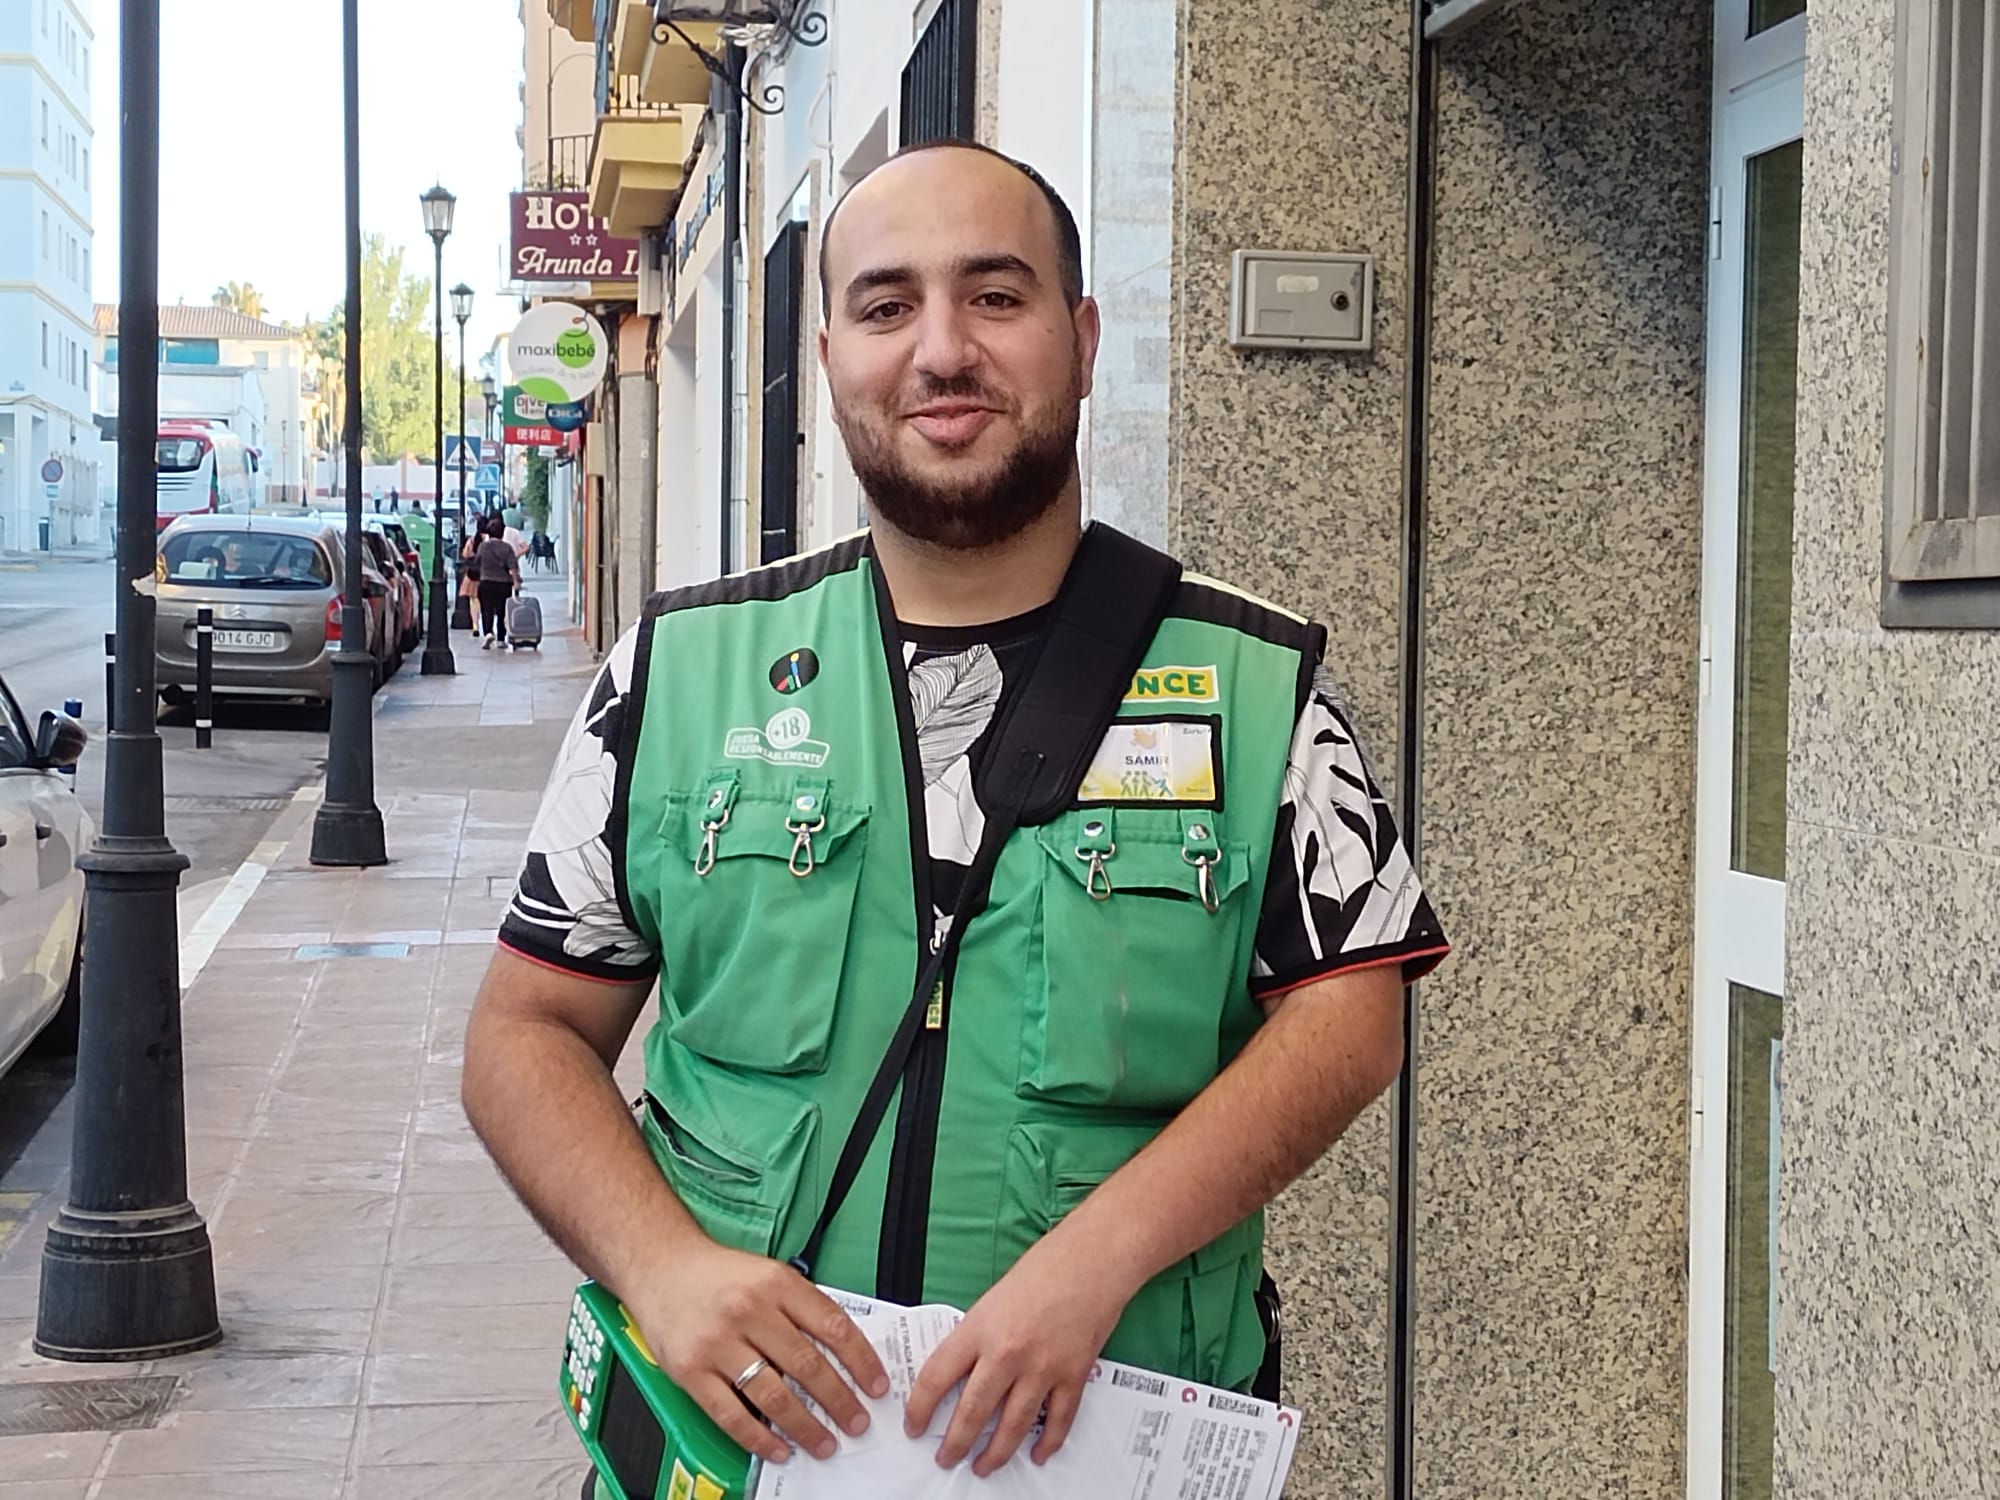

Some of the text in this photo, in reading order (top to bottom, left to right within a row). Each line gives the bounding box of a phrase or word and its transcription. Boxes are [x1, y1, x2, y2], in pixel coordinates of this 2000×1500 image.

[517, 246, 639, 275] Arunda I
[517, 342, 596, 358] maxibebé
[246, 633, 271, 645] GJC
[1135, 672, 1207, 696] NCE
[773, 716, 801, 740] +18
